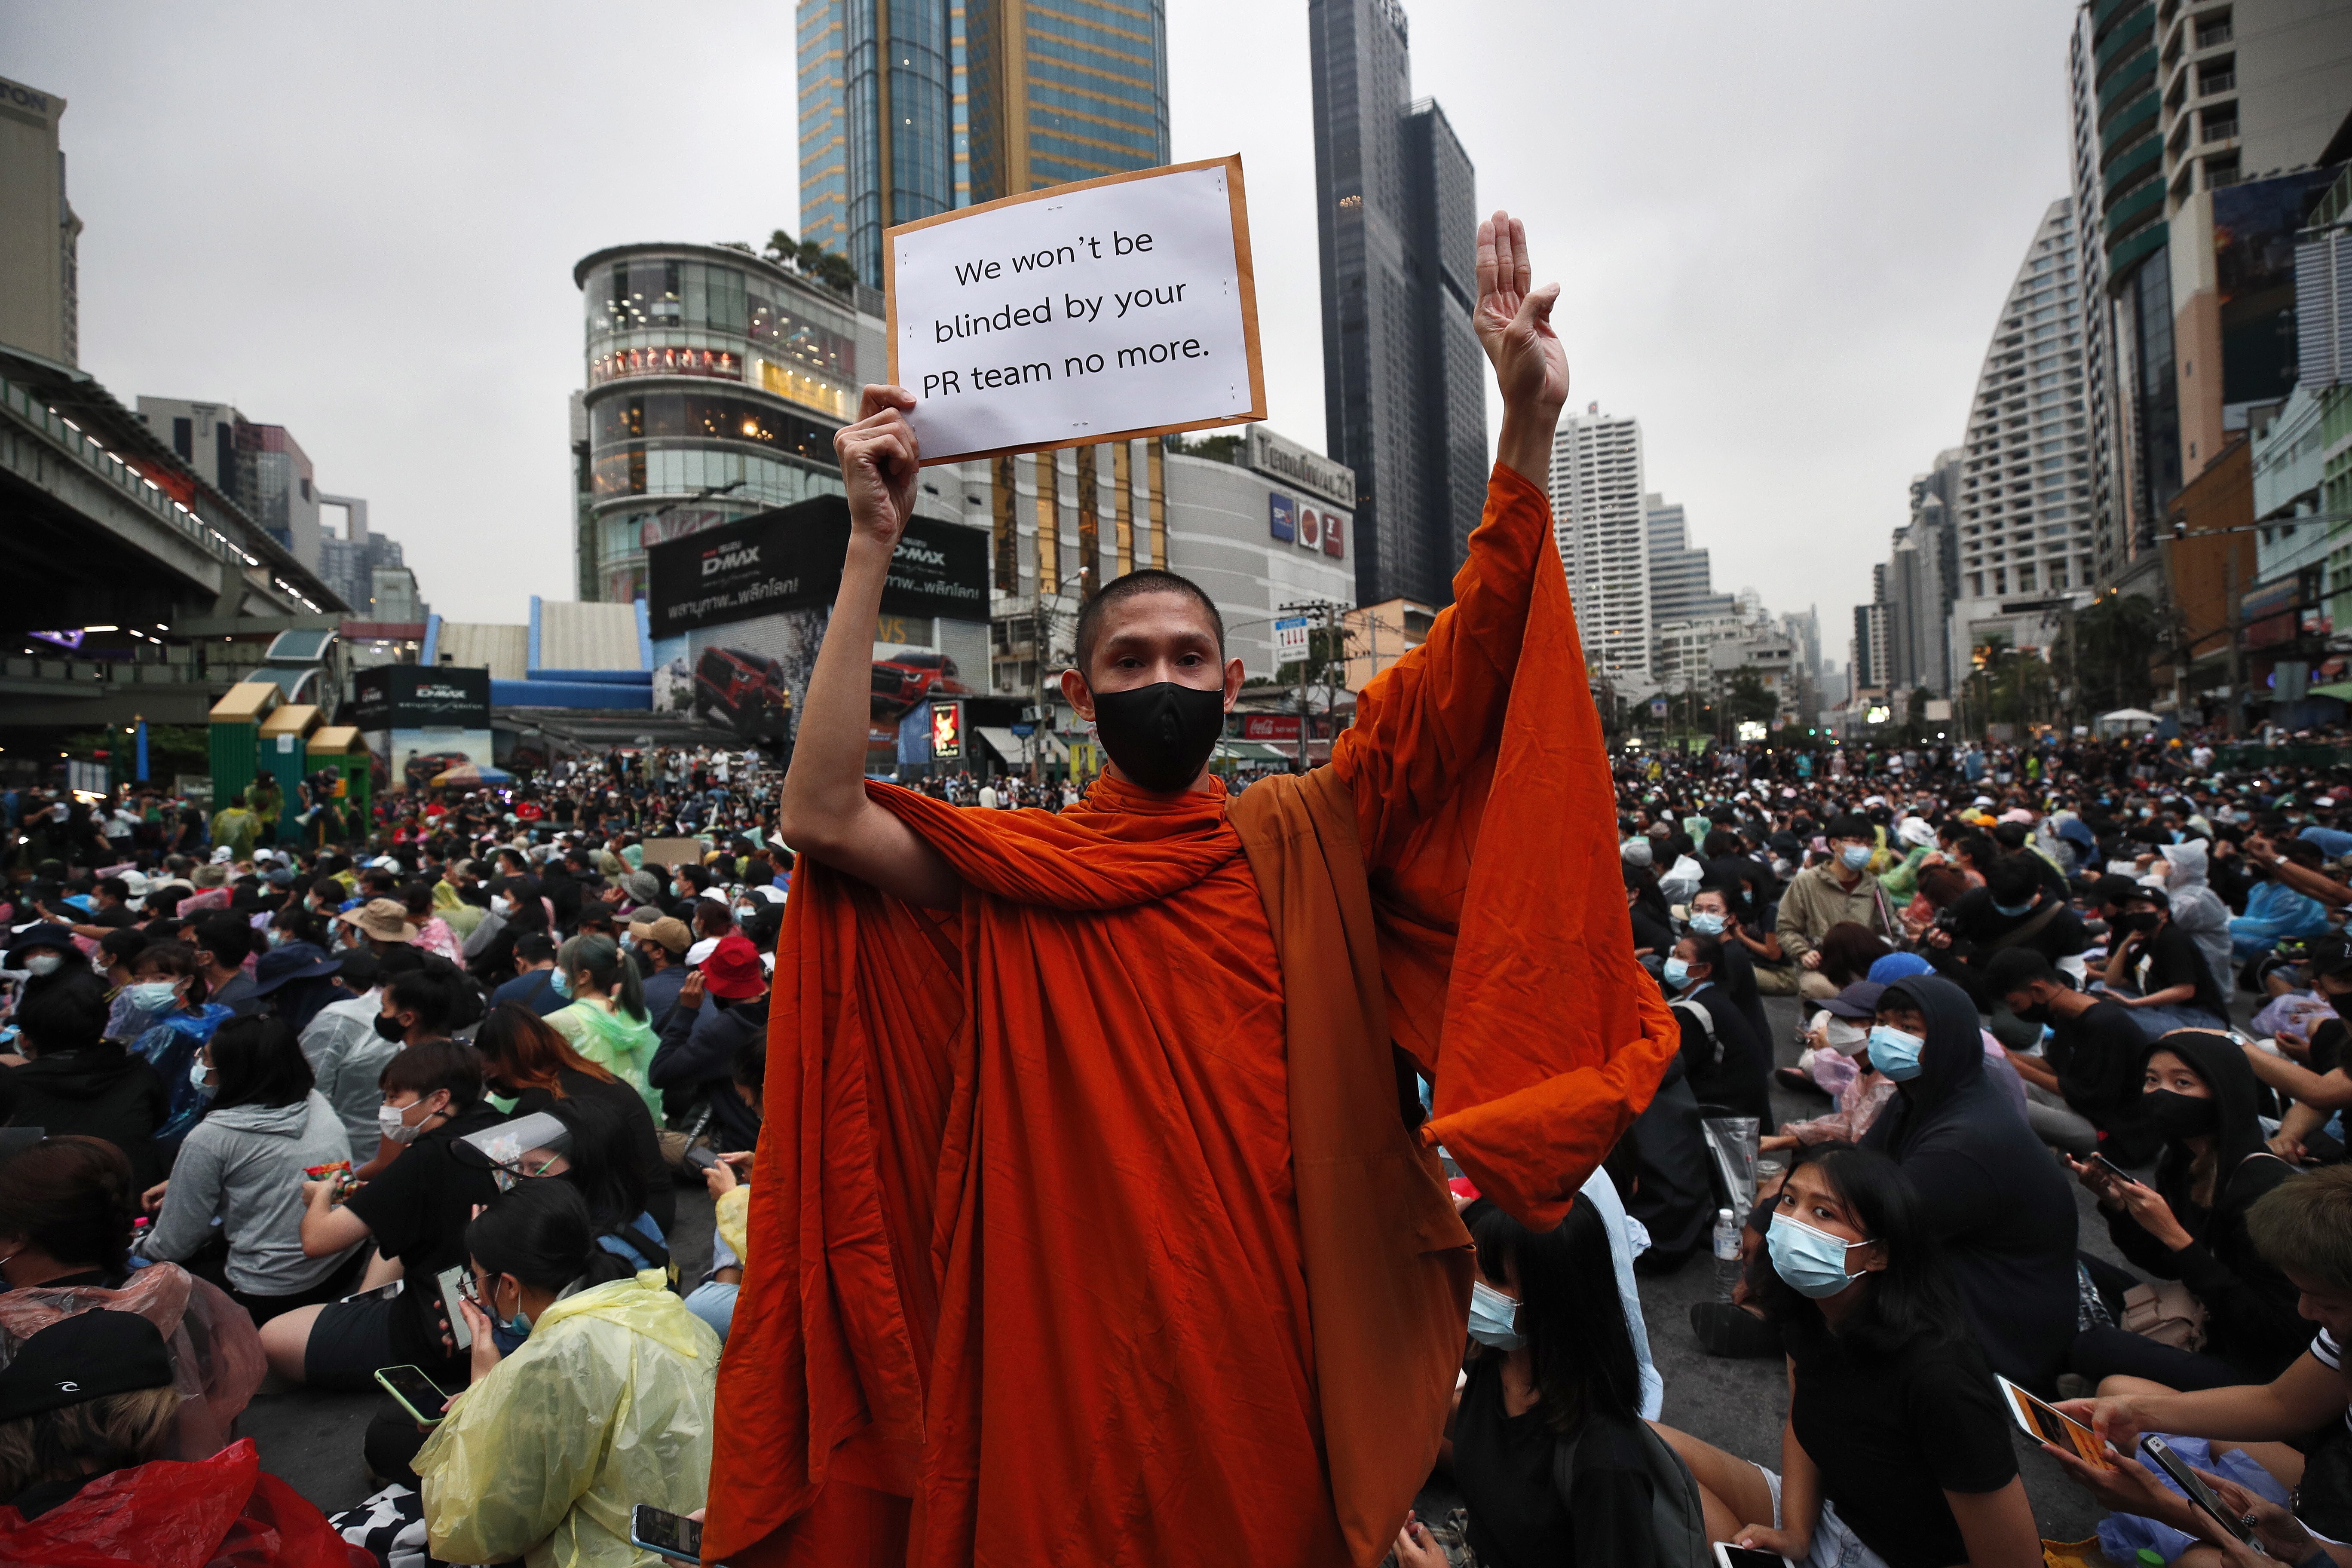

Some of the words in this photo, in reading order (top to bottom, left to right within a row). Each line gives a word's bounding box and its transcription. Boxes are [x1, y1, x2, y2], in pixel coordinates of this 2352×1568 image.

[954, 259, 1001, 286] We
[1113, 230, 1153, 256] be
[935, 296, 1052, 344] blinded
[1064, 293, 1103, 323] by
[1113, 283, 1187, 319] your
[923, 370, 961, 399] PR
[970, 362, 1052, 391] team
[1064, 353, 1105, 378] no
[1117, 338, 1209, 369] more.
